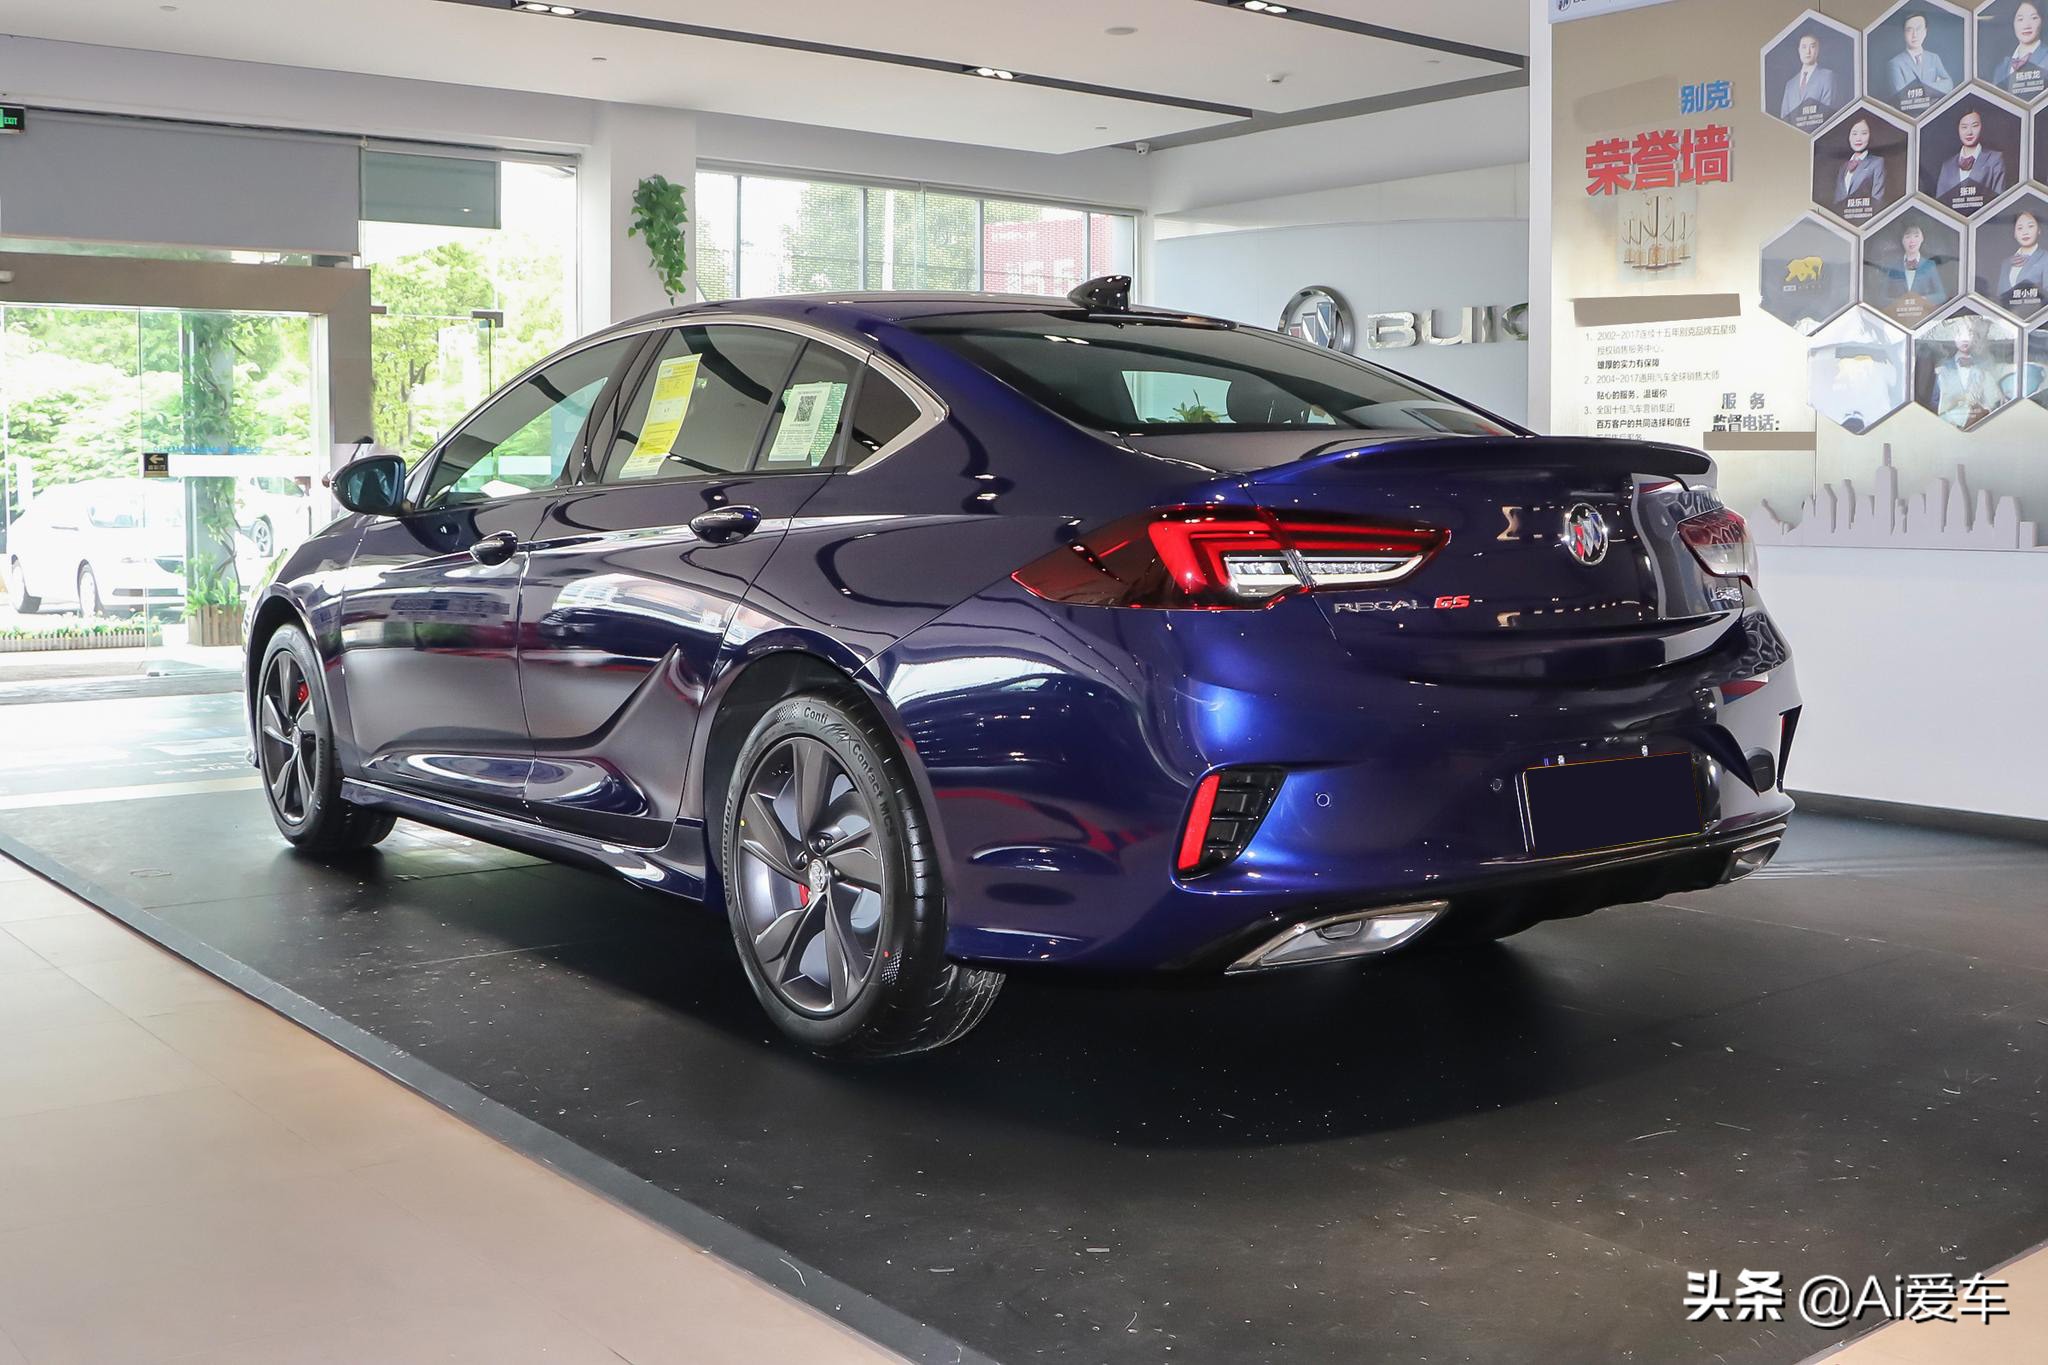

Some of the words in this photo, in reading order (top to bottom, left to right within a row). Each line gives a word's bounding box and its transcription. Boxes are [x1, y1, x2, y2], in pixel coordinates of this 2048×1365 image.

[1680, 80, 1734, 115] 别克
[1585, 124, 1732, 196] 荣誉墙
[1334, 599, 1431, 614] REGAL
[1433, 595, 1471, 609] GS
[803, 706, 830, 725] Conti
